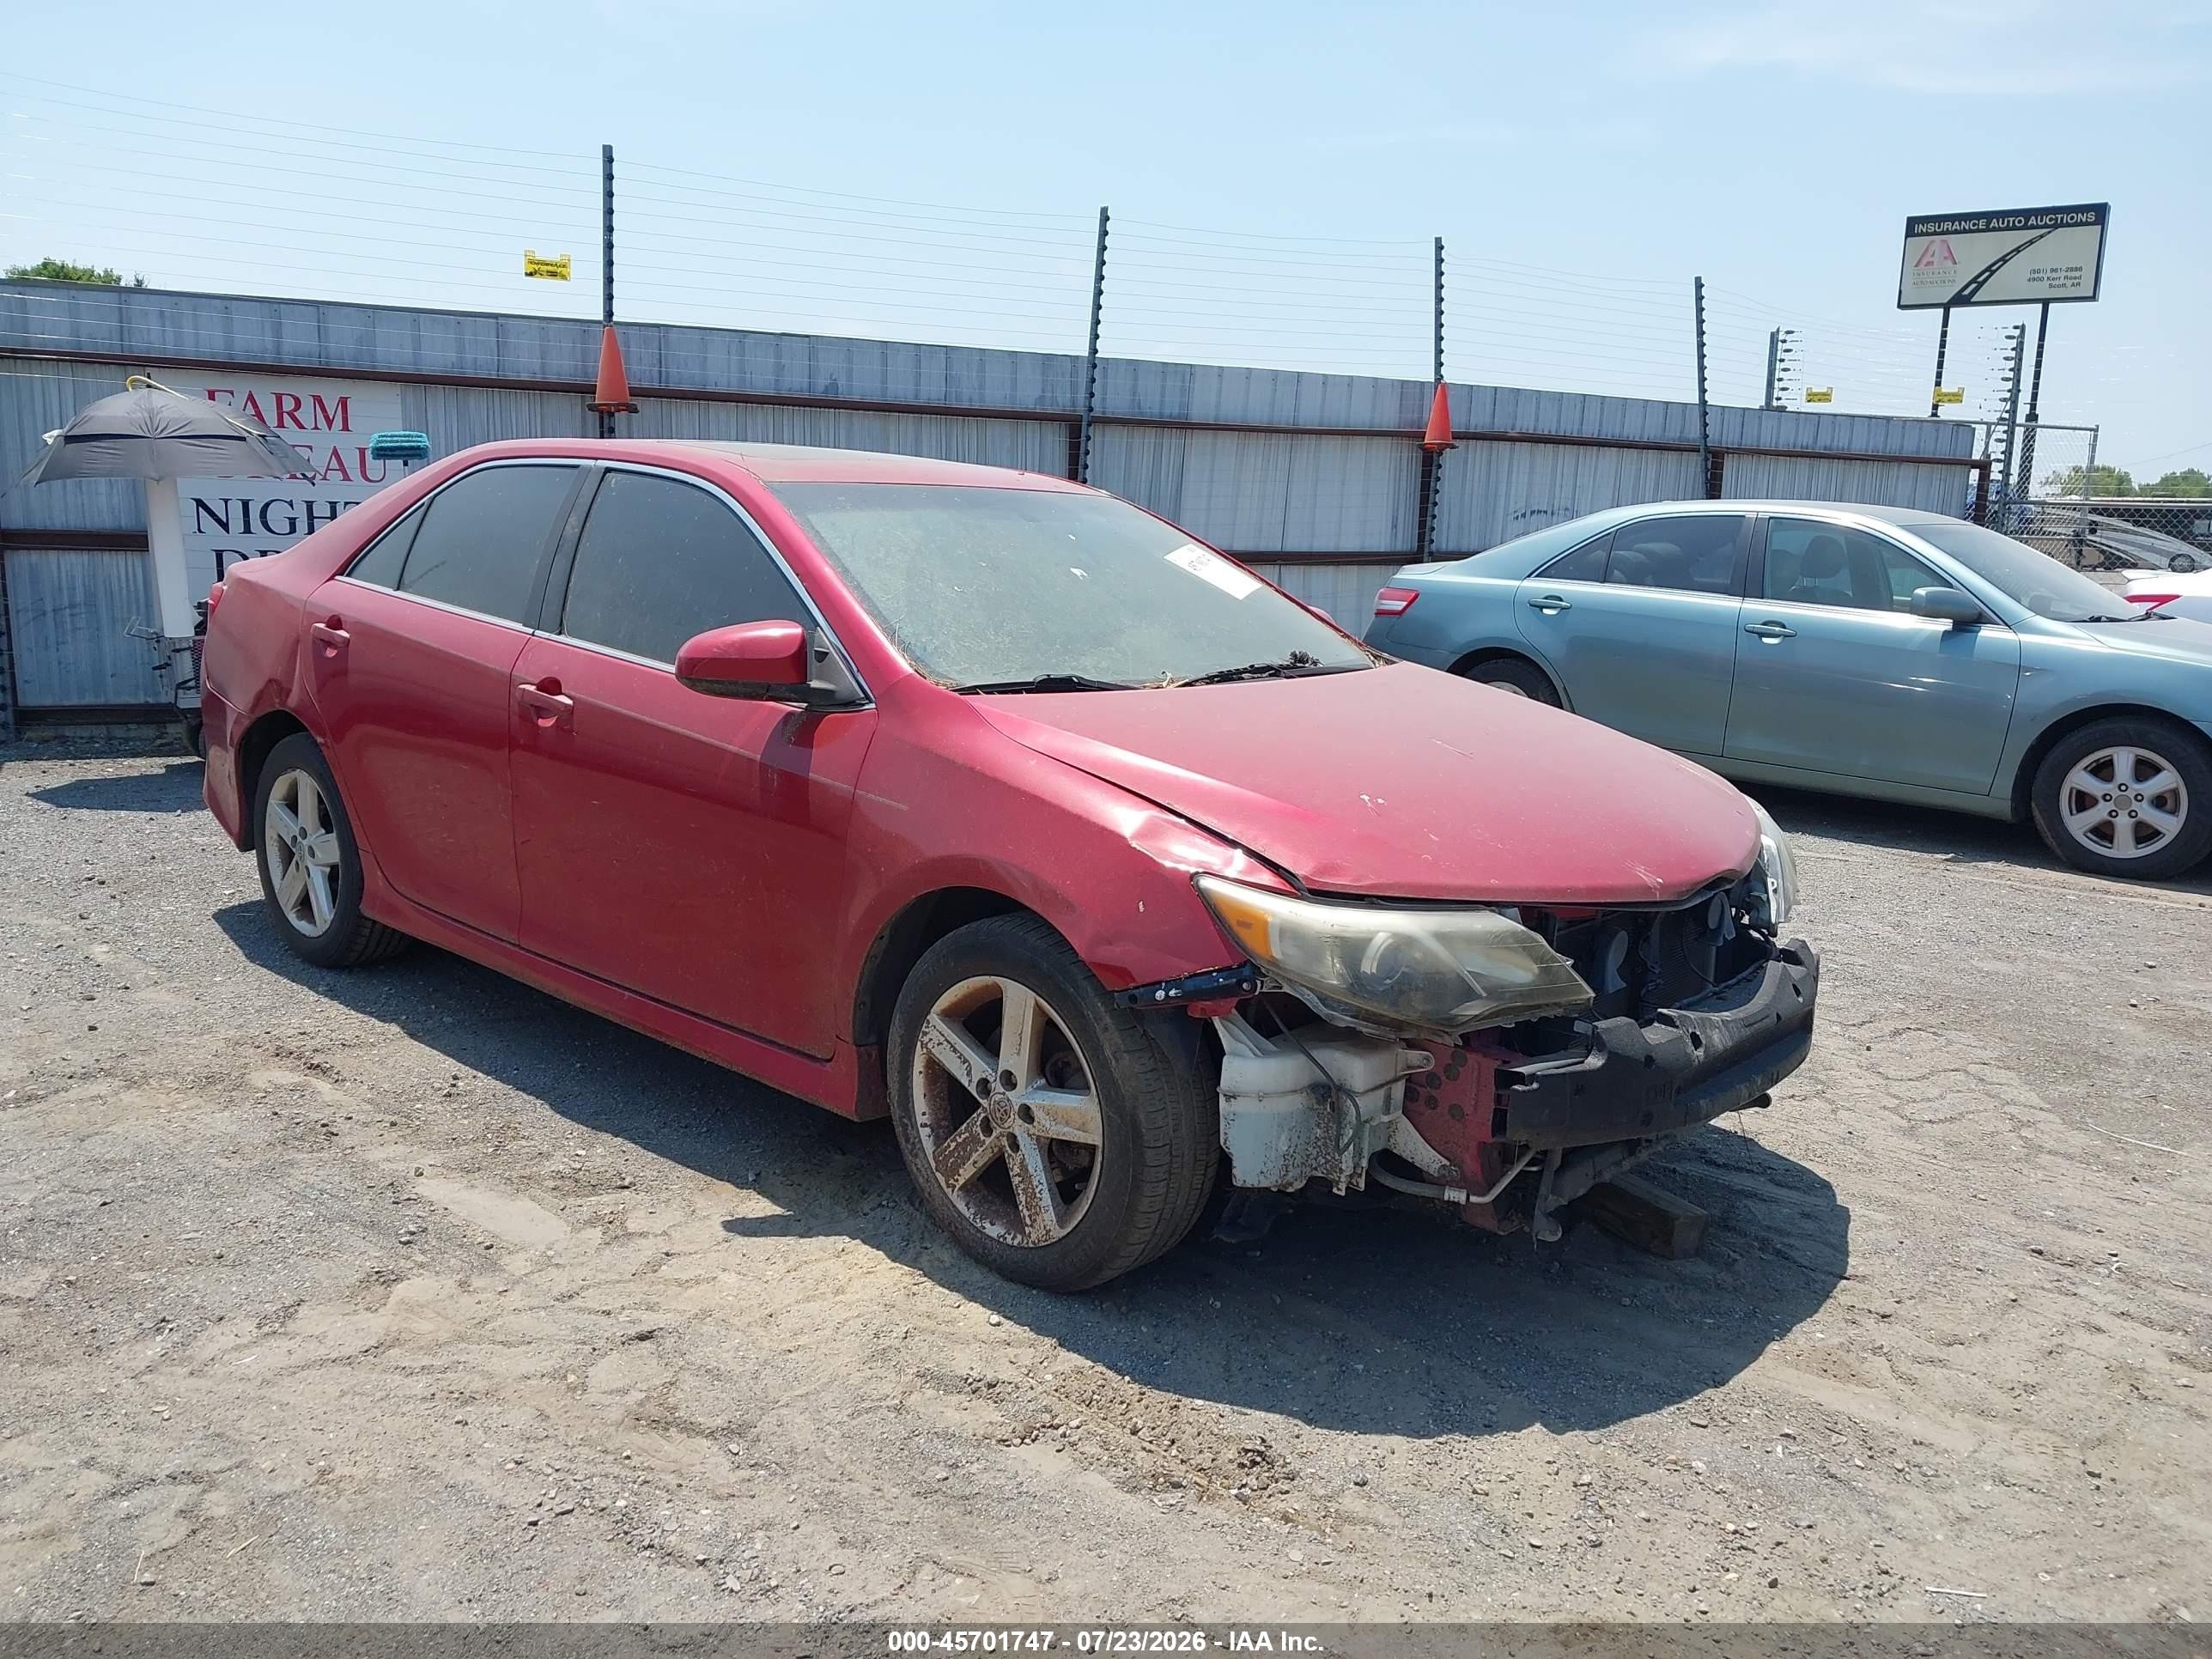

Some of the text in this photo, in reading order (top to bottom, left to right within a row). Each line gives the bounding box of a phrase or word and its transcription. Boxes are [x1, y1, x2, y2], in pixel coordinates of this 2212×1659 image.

[1914, 211, 2095, 234] INSURANCE AUTO AUCTIONS
[191, 497, 362, 536] NIGH
